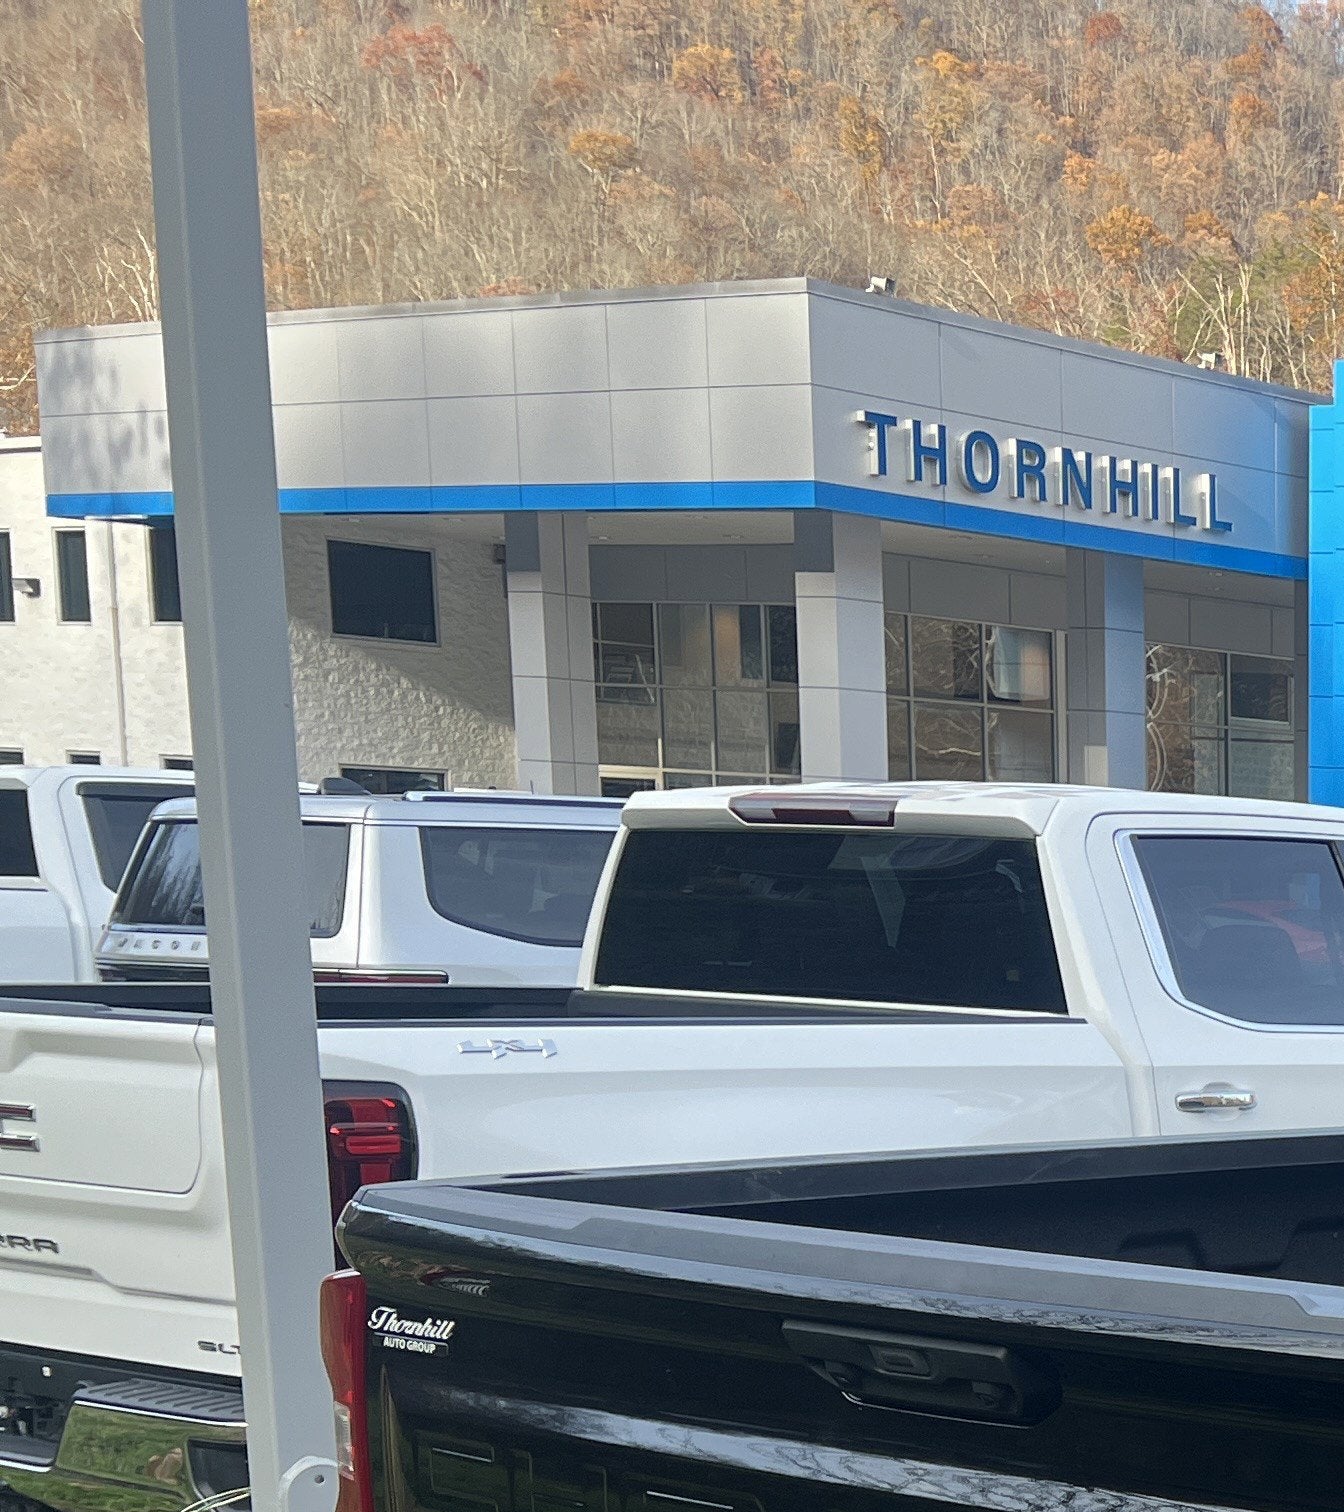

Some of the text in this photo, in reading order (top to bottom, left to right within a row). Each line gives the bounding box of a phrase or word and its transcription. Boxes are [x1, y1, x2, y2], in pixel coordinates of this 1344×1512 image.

[856, 409, 1233, 532] THORNHILL
[367, 1306, 456, 1340] Thornhill
[382, 1336, 437, 1354] AUTO GROUP
